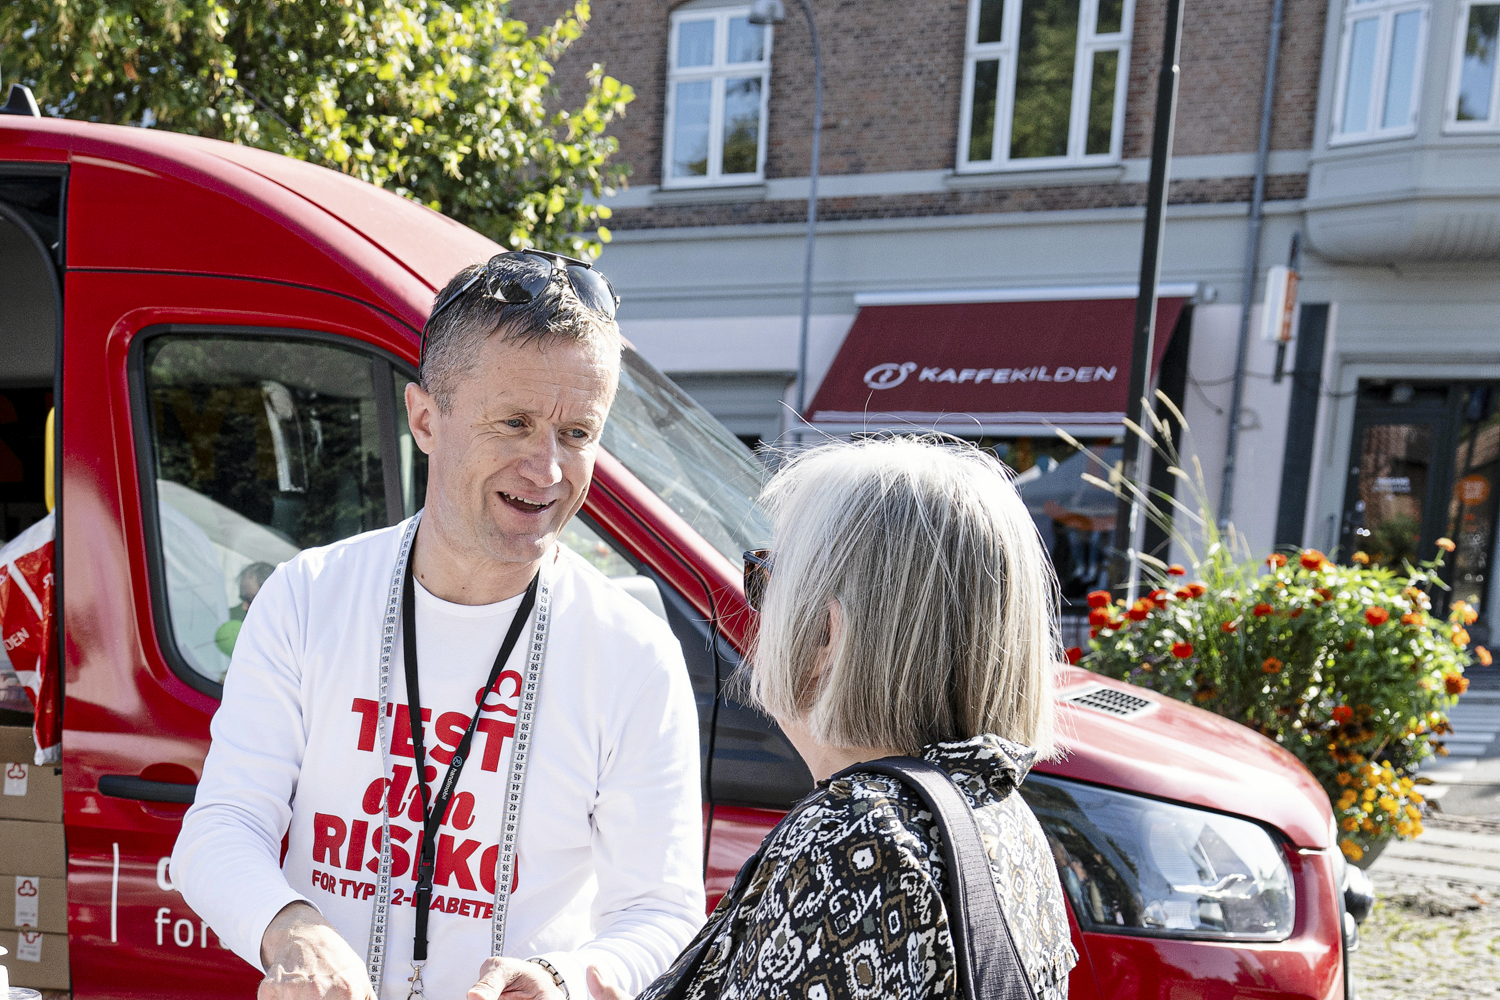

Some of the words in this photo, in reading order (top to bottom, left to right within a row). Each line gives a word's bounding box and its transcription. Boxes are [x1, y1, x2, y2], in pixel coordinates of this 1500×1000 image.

[918, 365, 1118, 384] KAFFEKILDEN
[351, 697, 516, 772] TEST
[361, 763, 476, 831] din
[311, 869, 336, 894] FOR
